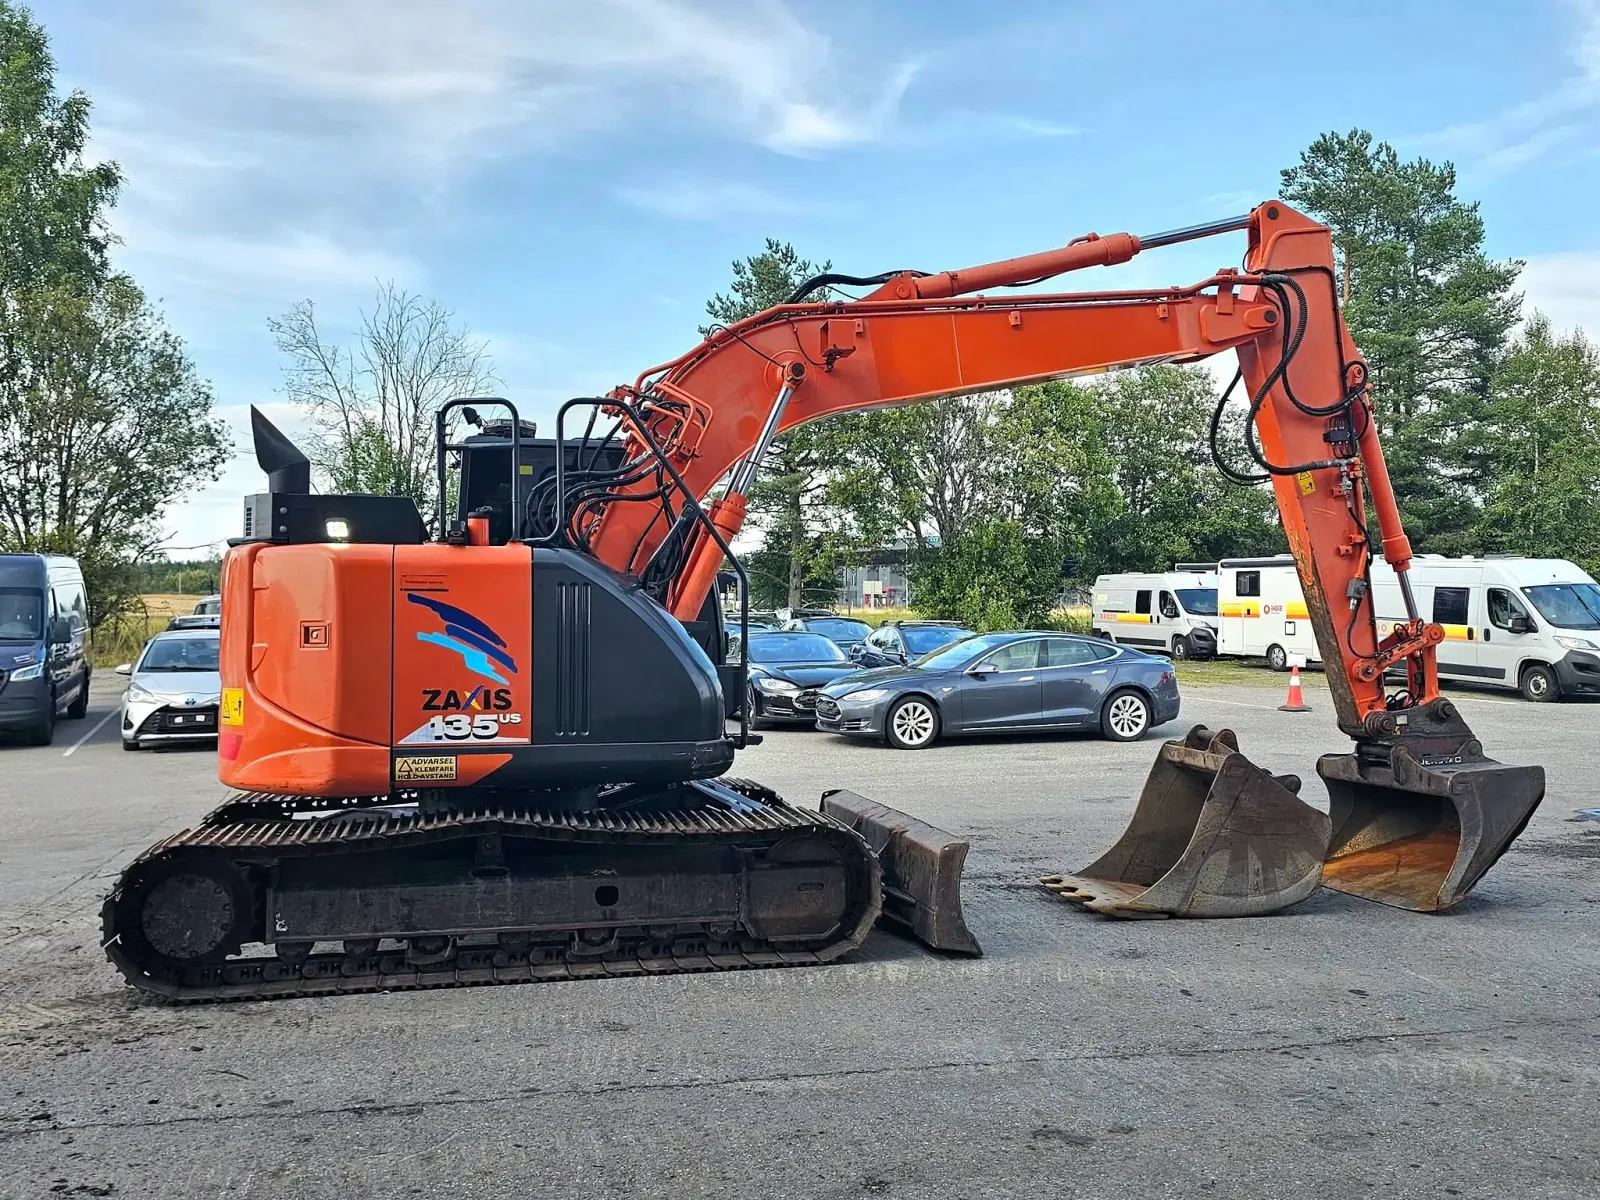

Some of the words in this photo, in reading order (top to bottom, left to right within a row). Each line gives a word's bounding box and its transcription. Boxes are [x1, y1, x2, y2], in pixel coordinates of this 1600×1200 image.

[422, 684, 512, 710] ZAXIS
[430, 714, 499, 740] 135
[411, 757, 454, 765] ADVARSEL
